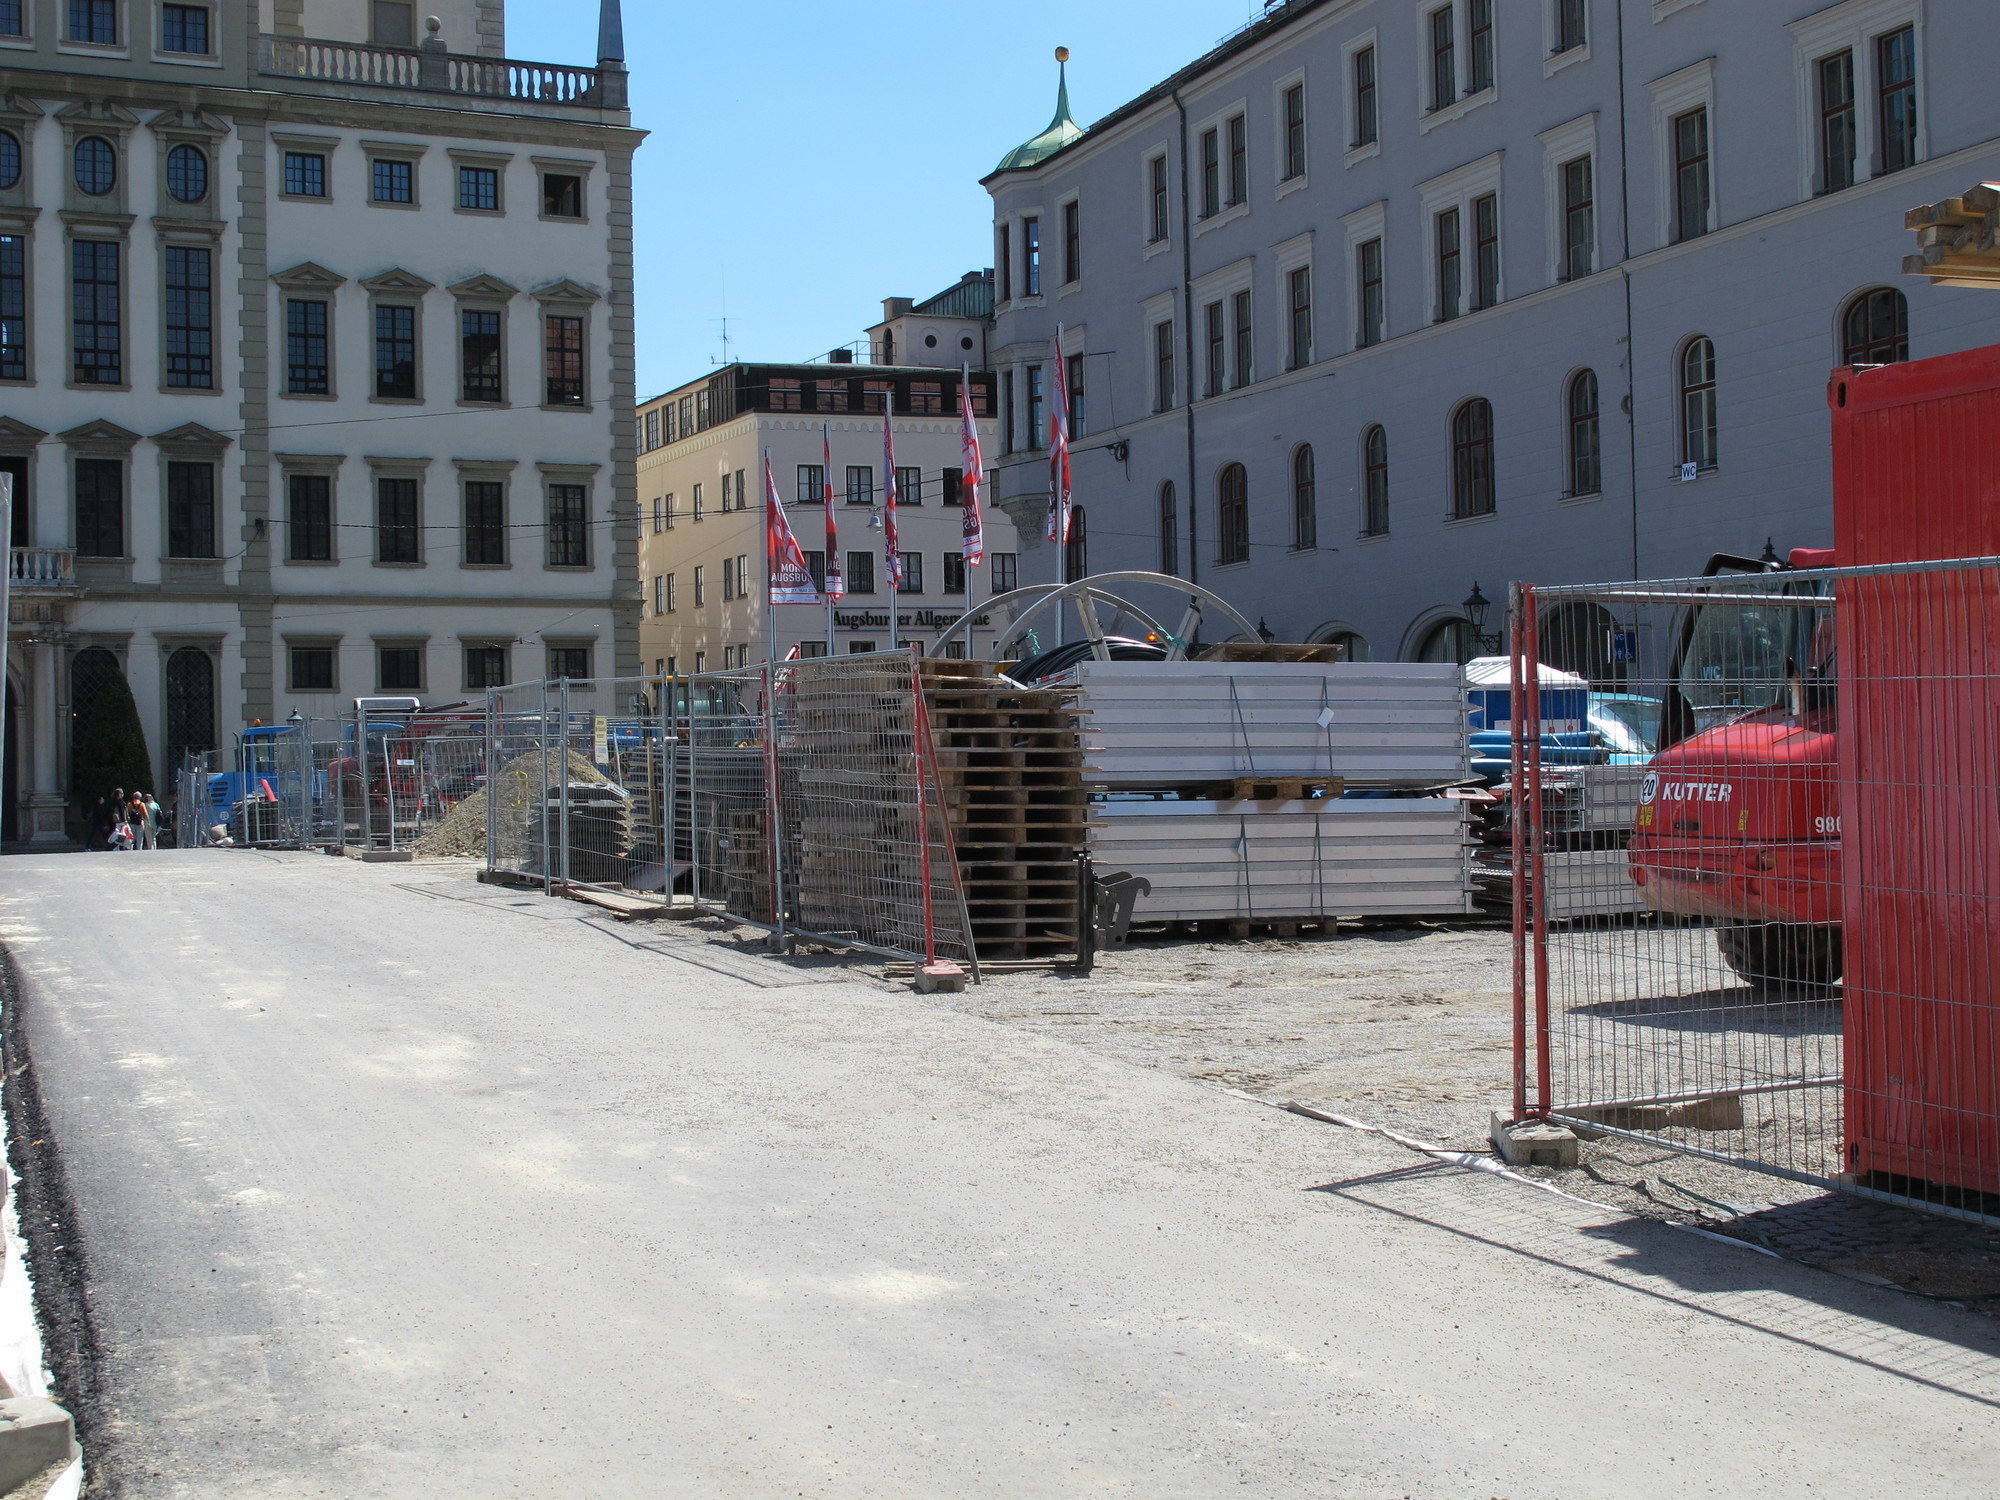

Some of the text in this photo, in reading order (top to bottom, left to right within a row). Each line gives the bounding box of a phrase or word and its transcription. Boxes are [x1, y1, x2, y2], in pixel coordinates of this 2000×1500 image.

[1682, 465, 1696, 478] WC
[770, 573, 810, 582] AUGSBU
[833, 610, 912, 630] Augsburer
[1643, 778, 1656, 797] 20
[1662, 782, 1733, 802] KUTTER
